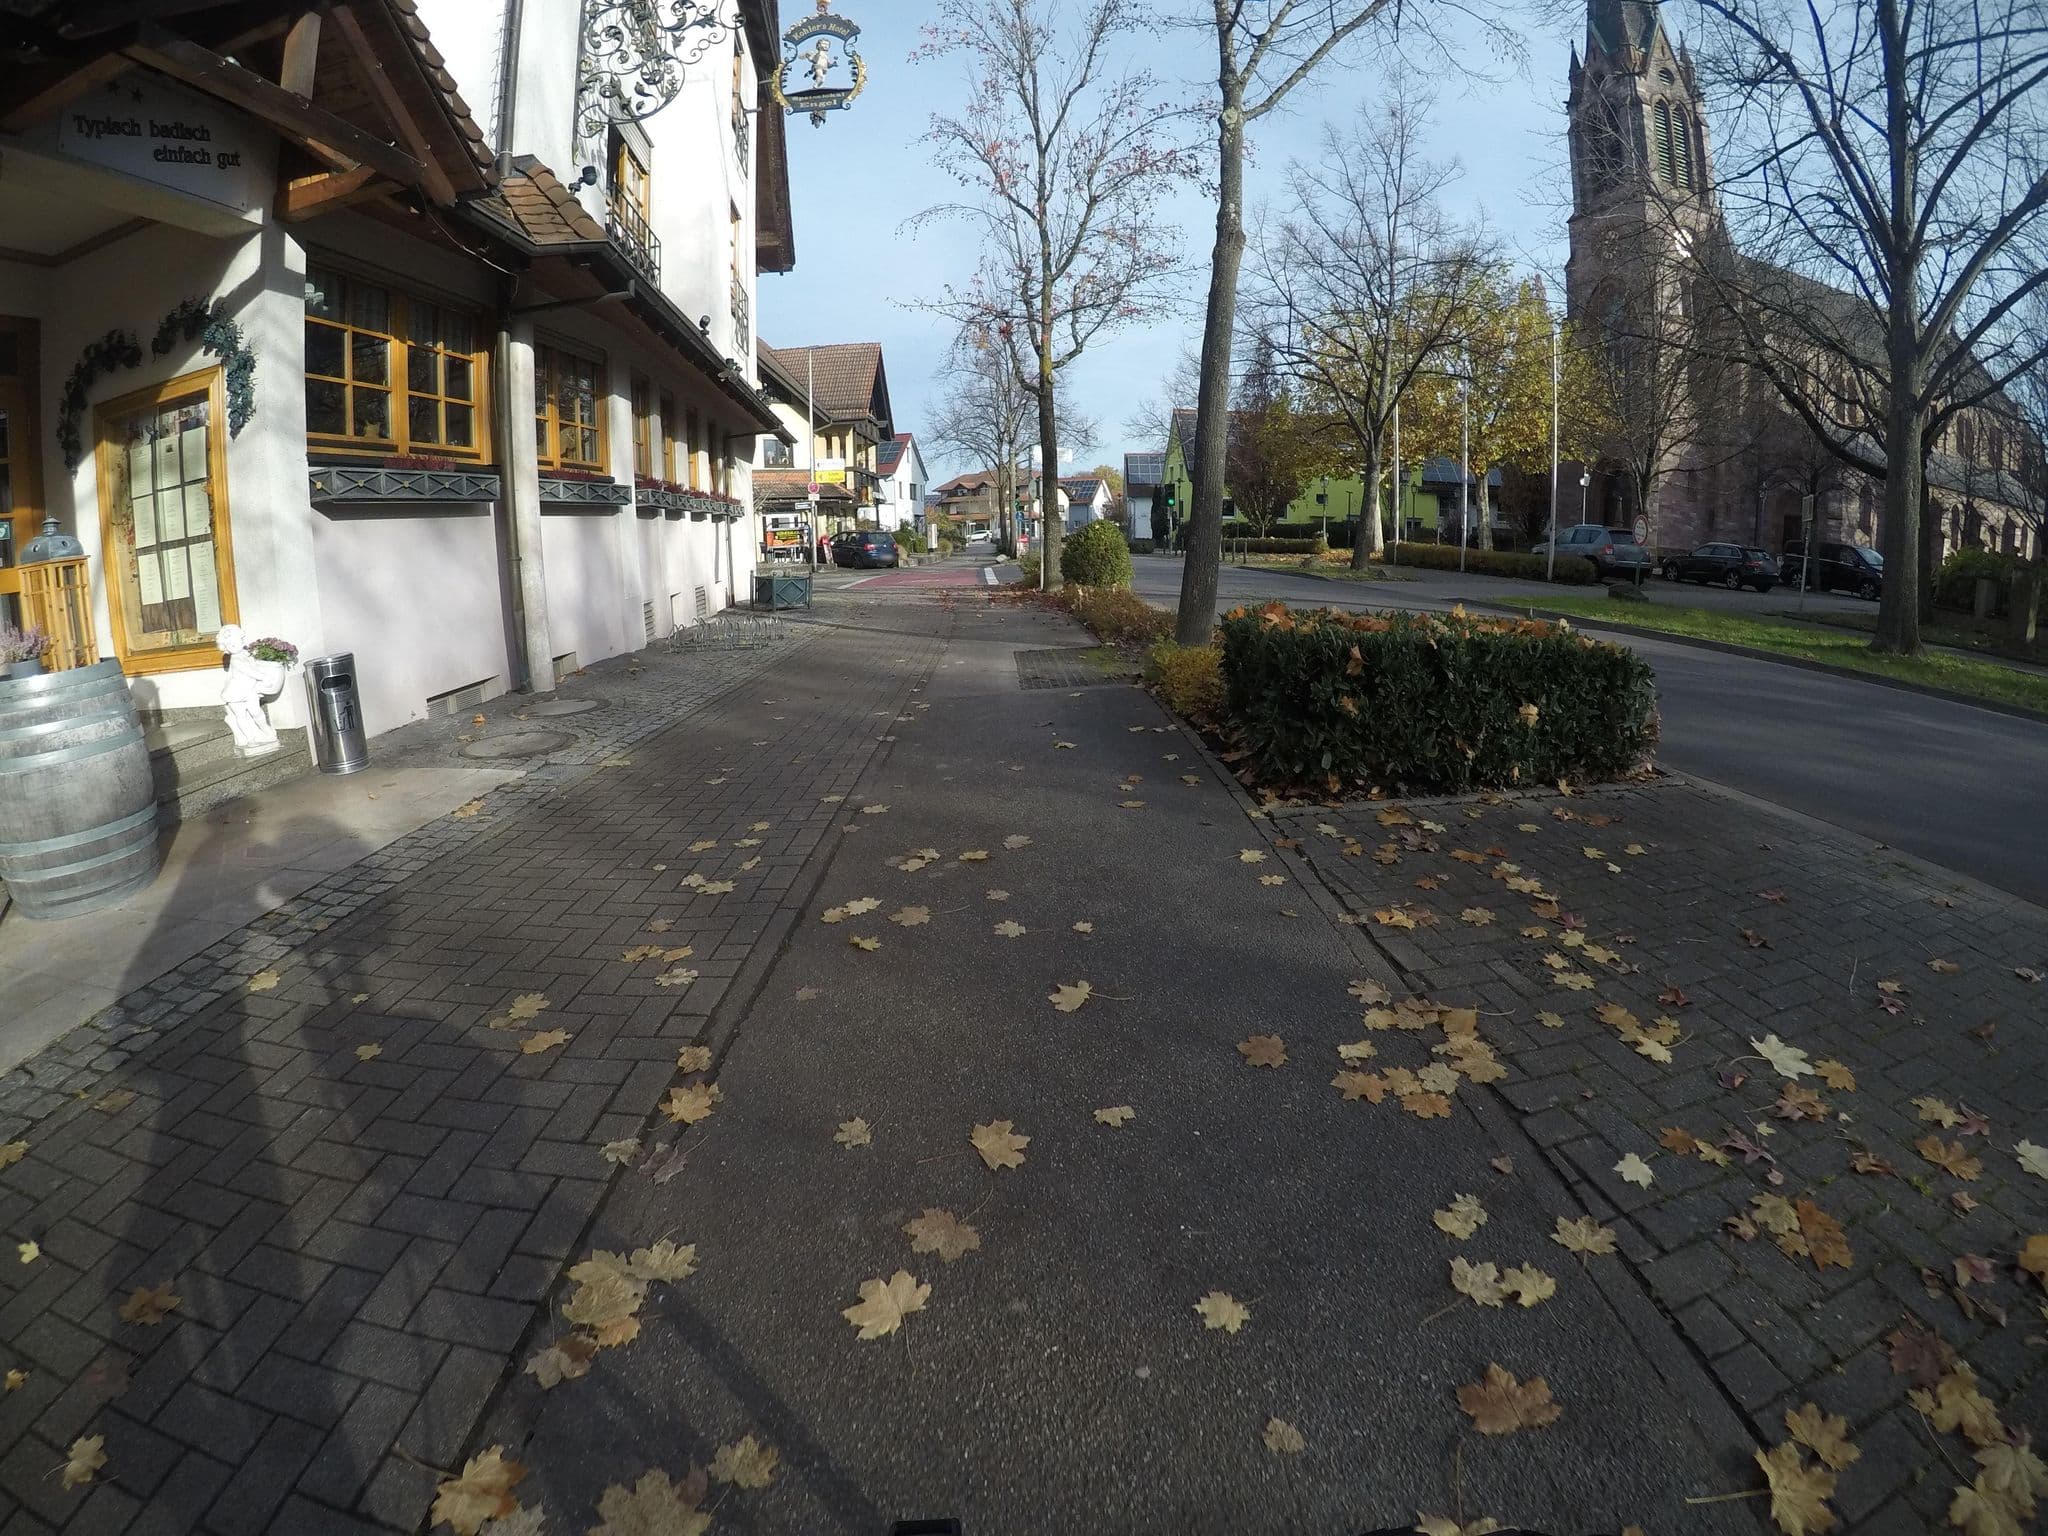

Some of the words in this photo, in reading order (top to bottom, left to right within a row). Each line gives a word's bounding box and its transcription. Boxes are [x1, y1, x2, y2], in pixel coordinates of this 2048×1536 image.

[828, 23, 850, 36] Hotel
[800, 100, 837, 108] Engel
[73, 114, 142, 139] Typisch
[149, 120, 211, 142] badisch
[153, 145, 211, 165] einfach
[217, 151, 241, 169] gut
